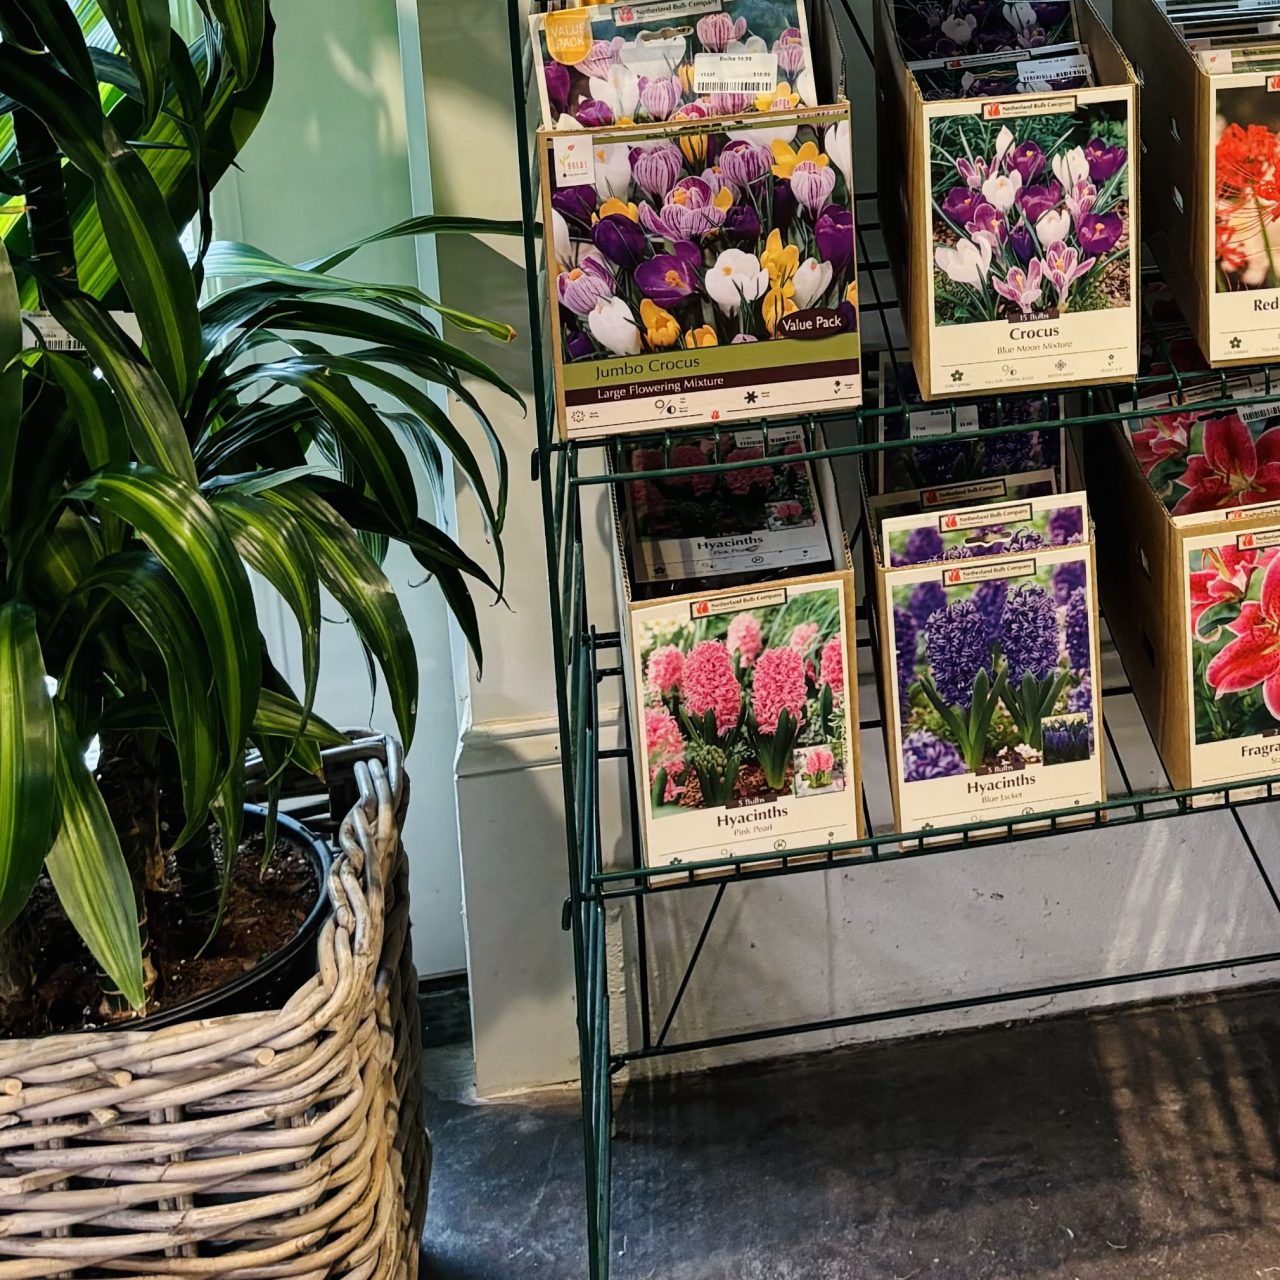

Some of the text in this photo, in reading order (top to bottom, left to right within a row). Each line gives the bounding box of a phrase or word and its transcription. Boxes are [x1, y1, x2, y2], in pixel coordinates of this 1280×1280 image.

[636, 3, 672, 15] Netherland
[552, 23, 585, 36] VALUE
[556, 36, 585, 49] PACK
[1254, 297, 1279, 312] Red
[783, 315, 842, 332] Value Pack
[1009, 326, 1059, 341] Crocus
[998, 341, 1072, 355] Blue Moon Mixture
[596, 356, 700, 381] Jumbo Crocus
[598, 376, 724, 400] Large Flowering Mixture
[697, 535, 763, 550] Hyacinths
[967, 774, 1036, 795] Hyacinths
[982, 792, 1023, 803] Blue Jacket
[717, 806, 788, 828] Hyacinths
[734, 824, 773, 836] Pink Pearl
